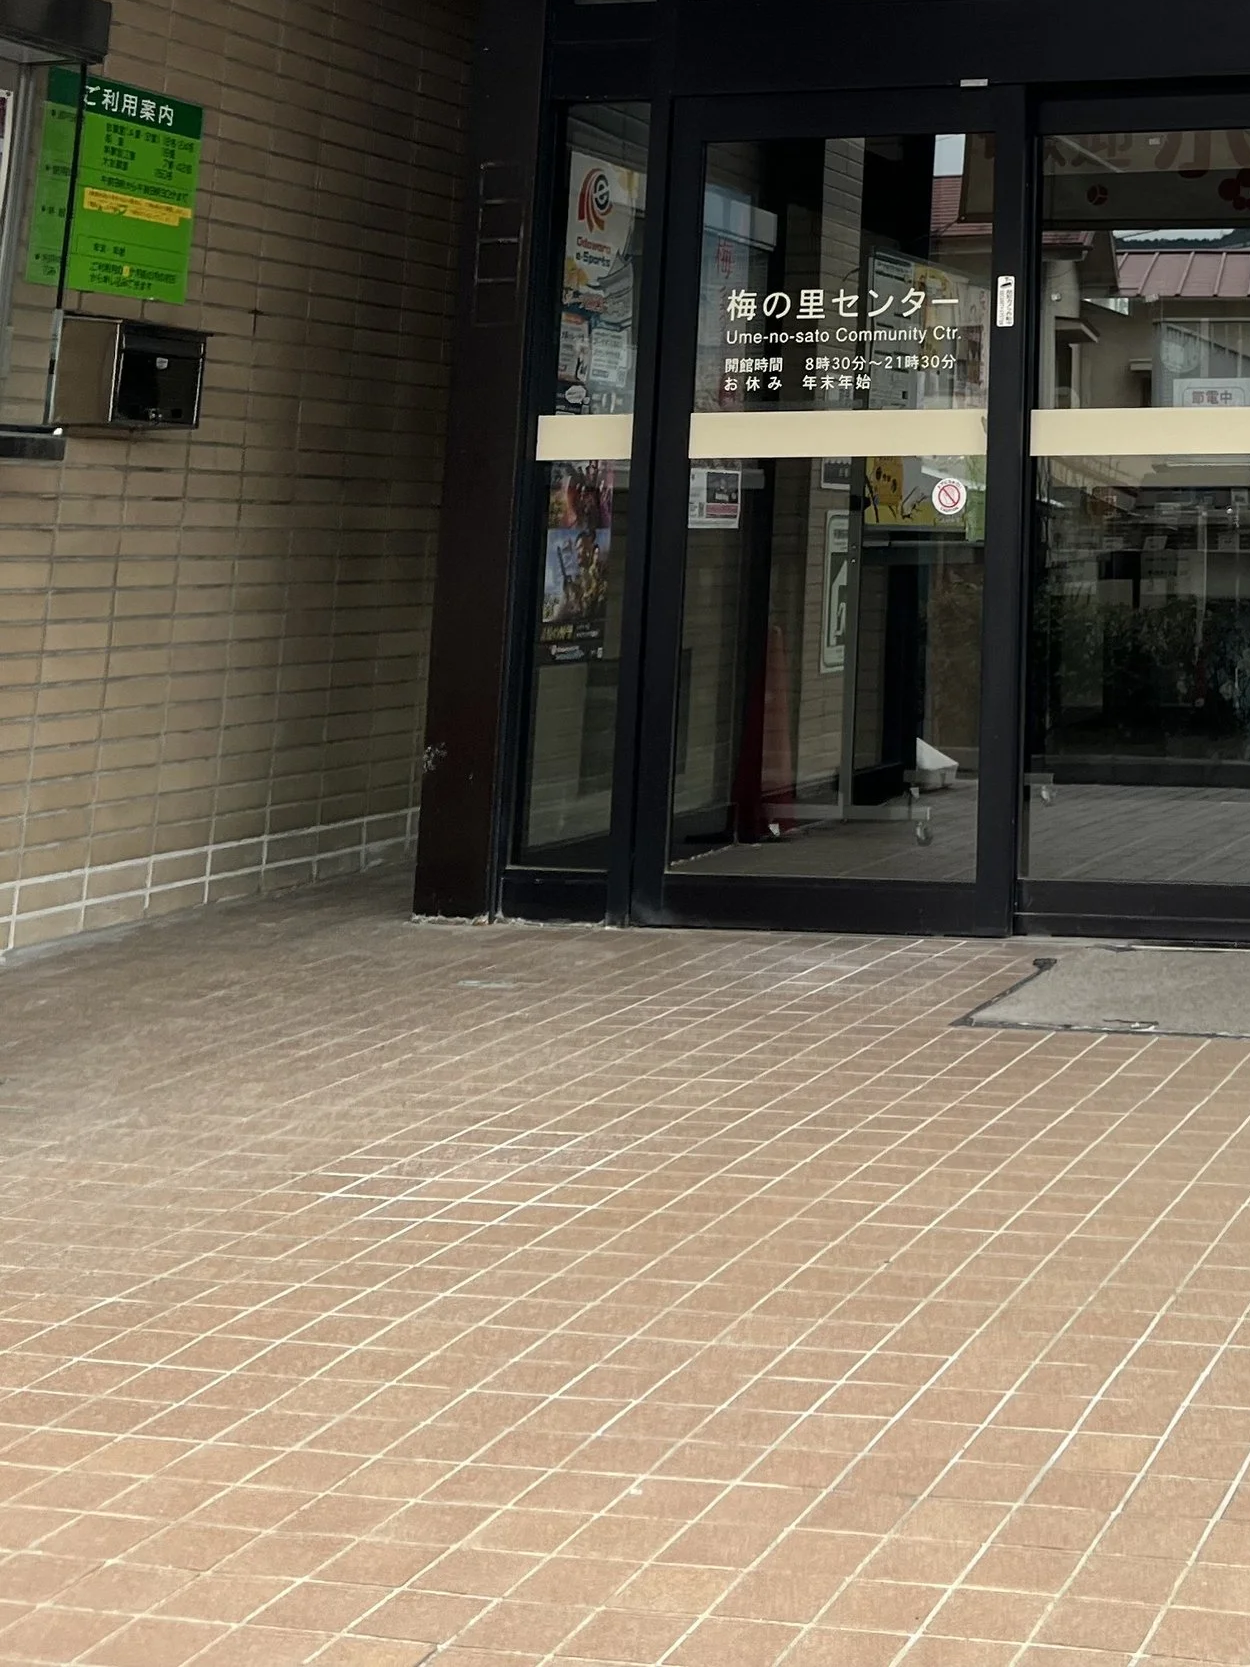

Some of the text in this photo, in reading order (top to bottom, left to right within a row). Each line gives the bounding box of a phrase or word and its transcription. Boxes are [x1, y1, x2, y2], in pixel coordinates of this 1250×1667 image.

[83, 84, 175, 127] ご利用案内
[726, 287, 960, 322] 梅の里センター
[726, 325, 962, 345] Ume-no-sato Community Ctr.
[724, 354, 957, 373] 開館時間 8時30分～21時30分
[724, 374, 872, 392] お休み 年末年始
